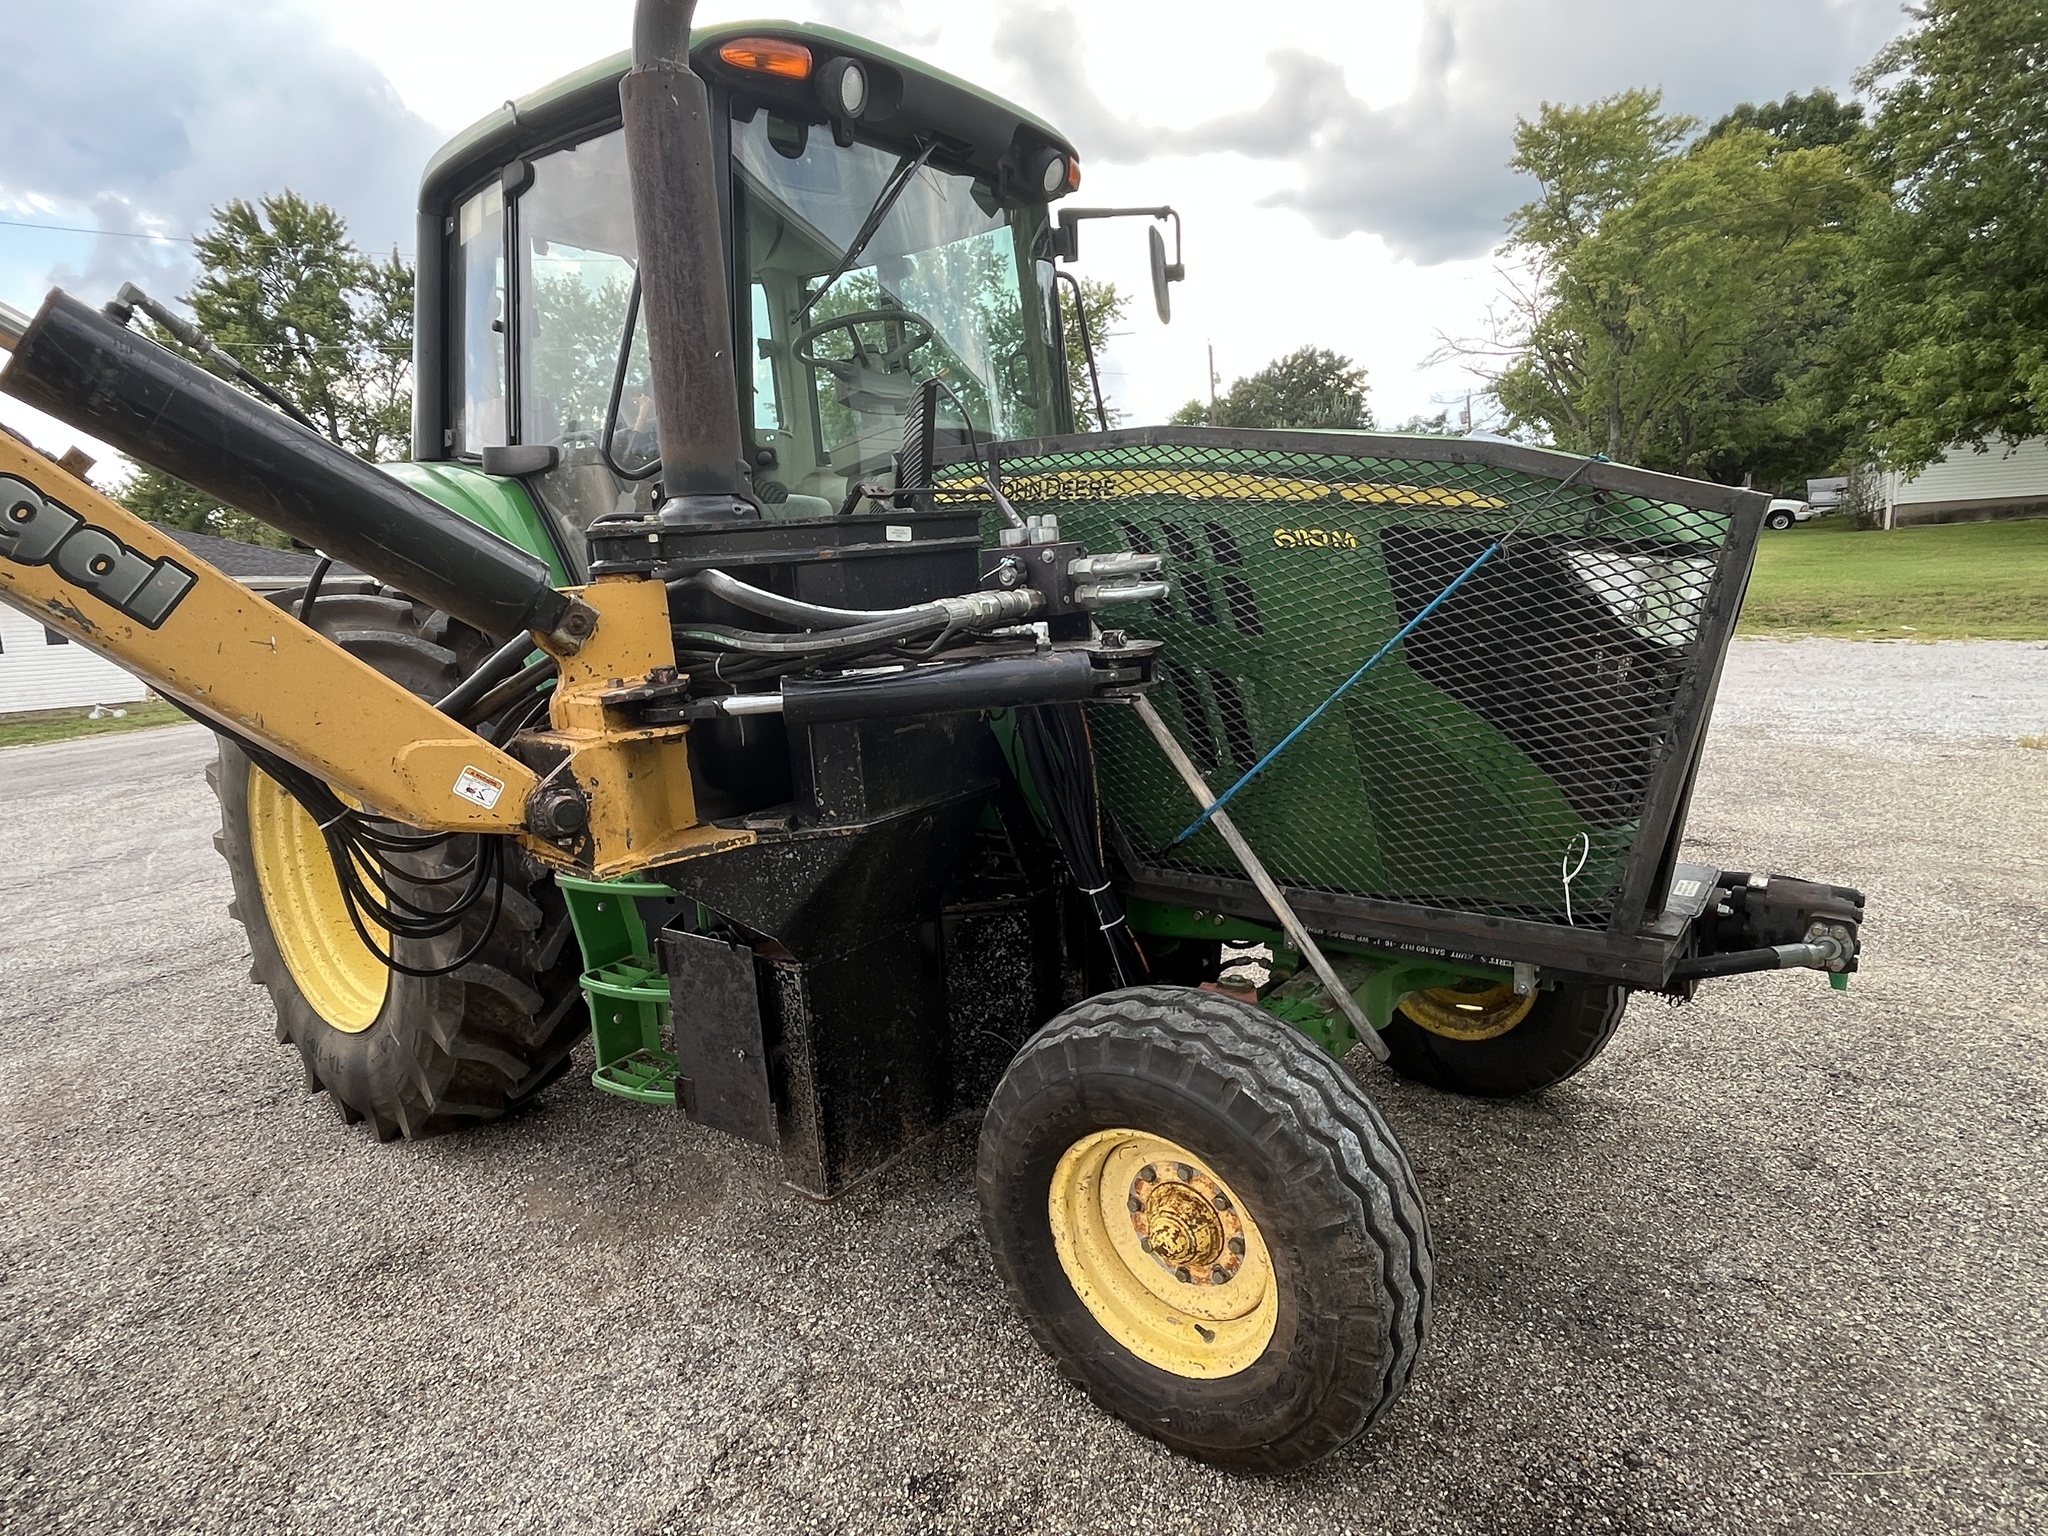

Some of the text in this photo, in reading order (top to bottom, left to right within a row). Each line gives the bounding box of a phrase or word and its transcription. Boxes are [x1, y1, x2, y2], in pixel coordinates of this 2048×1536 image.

[1000, 477, 1117, 500] OHN DEERE
[1450, 951, 1474, 961] KURT
